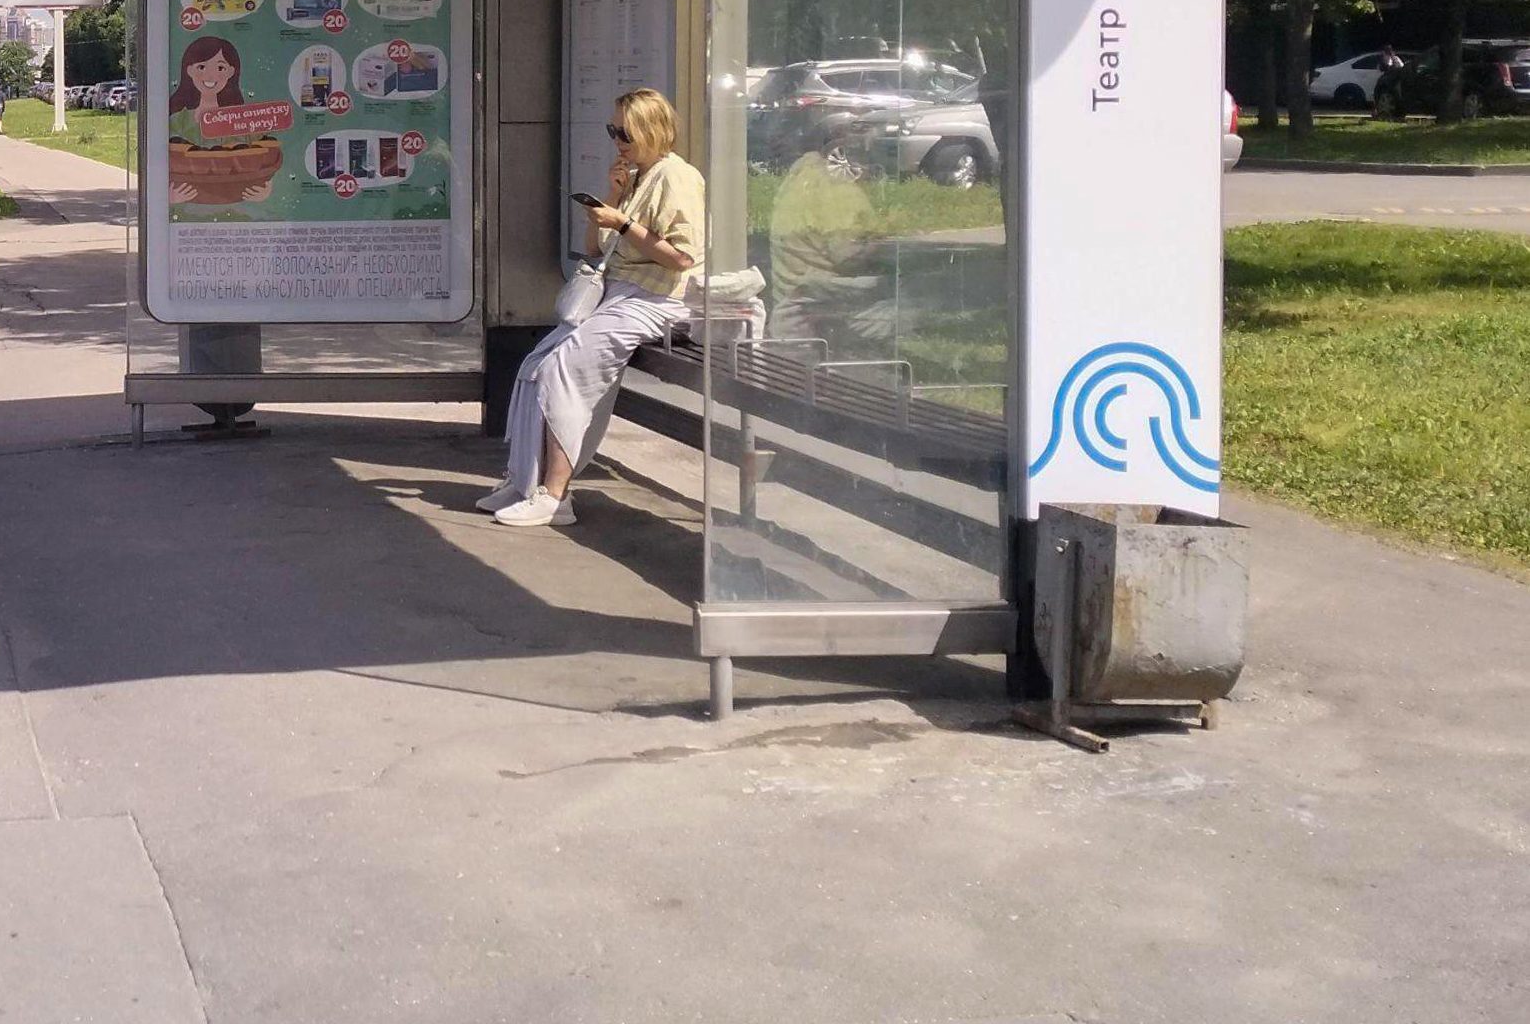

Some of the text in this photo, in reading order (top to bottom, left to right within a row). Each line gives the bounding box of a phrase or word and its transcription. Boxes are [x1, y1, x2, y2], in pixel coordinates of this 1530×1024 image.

[181, 12, 201, 26] 20
[325, 15, 345, 28] 20
[389, 45, 409, 58] 20
[1092, 8, 1127, 112] Театр
[329, 97, 349, 110] 20
[203, 104, 290, 125] Собери аптечку
[233, 116, 279, 132] на дачу!
[403, 137, 422, 150] 20
[336, 179, 356, 193] 20
[178, 255, 442, 276] ИМЕЮТСЯ ПРОТИВОПОКАЗАНИЯ НЕОБХОДИМО
[178, 279, 248, 300] ПОЛУЧЕНИЕ
[255, 278, 349, 300] КОНСУЛЬТАЦИИ
